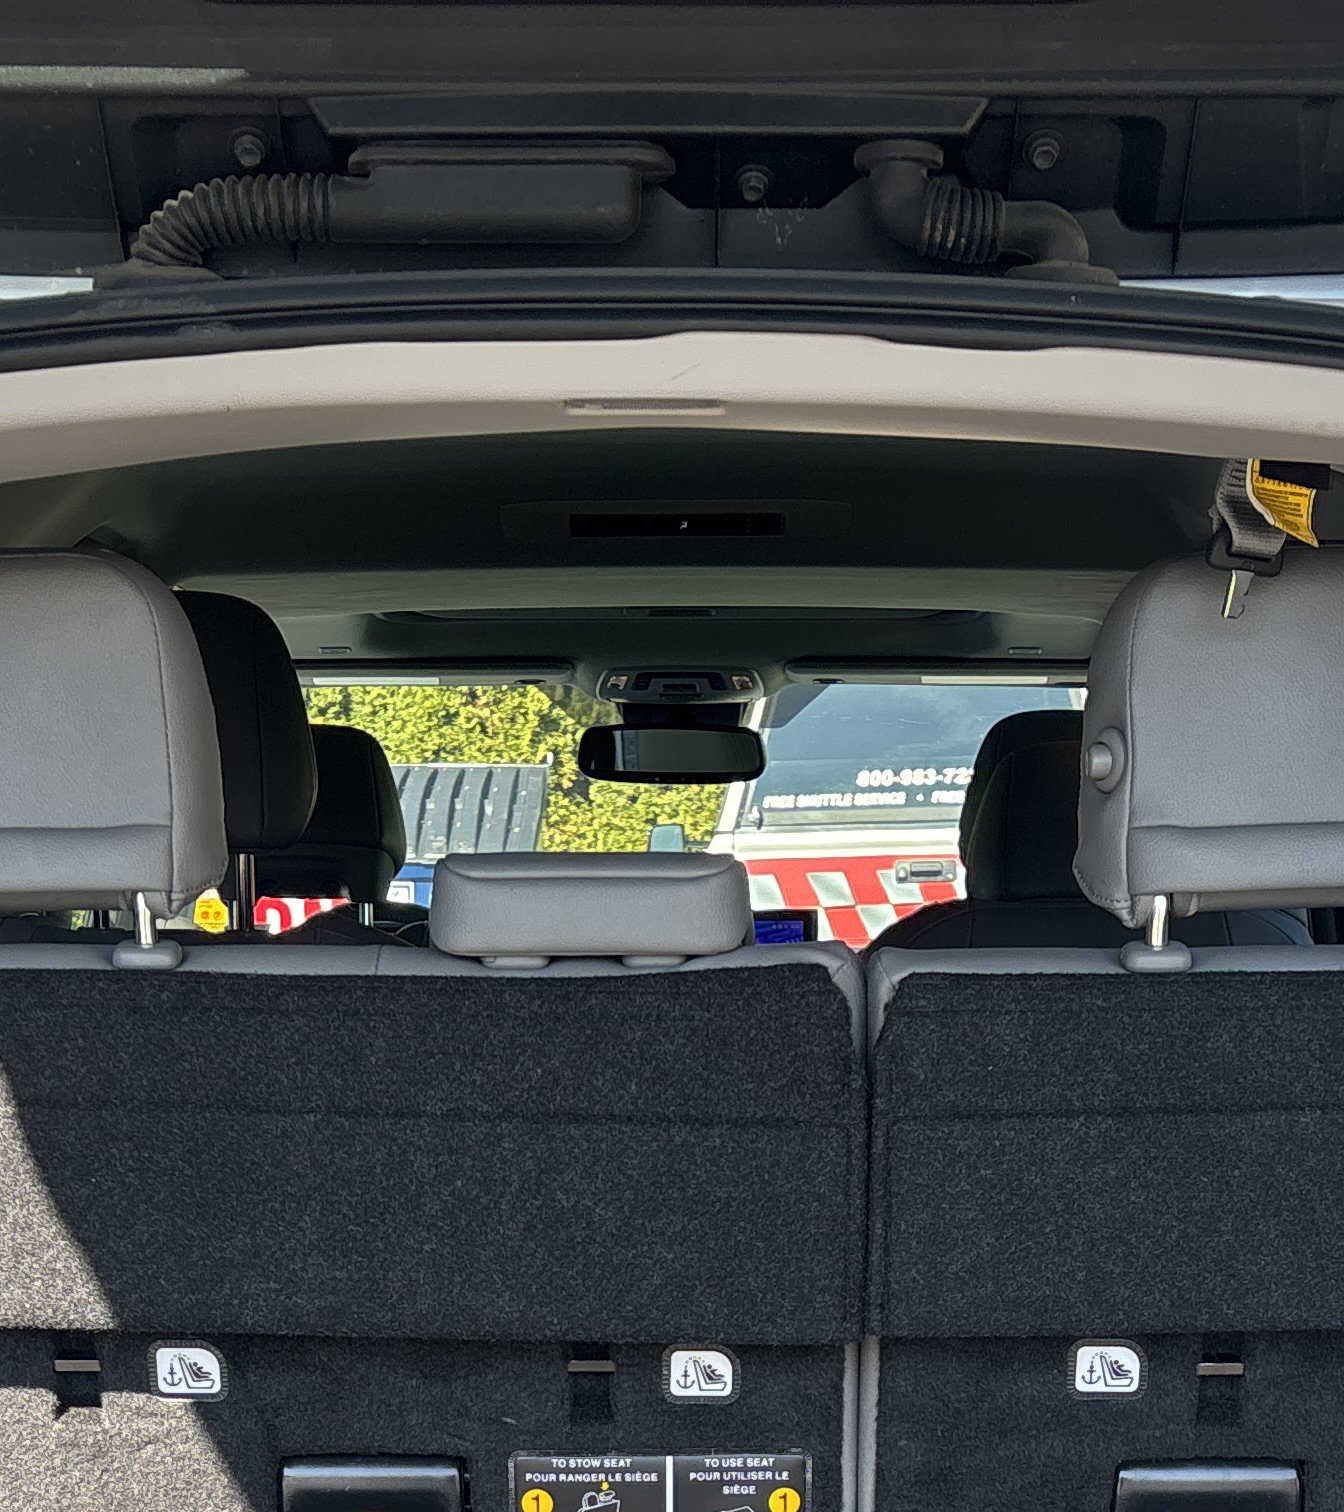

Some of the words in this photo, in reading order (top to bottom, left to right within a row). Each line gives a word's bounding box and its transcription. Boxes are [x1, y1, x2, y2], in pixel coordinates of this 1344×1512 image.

[796, 793, 854, 808] SHUTTLE
[854, 791, 906, 806] SERVICE
[551, 1458, 566, 1468] TO
[568, 1458, 601, 1468] STOW
[603, 1458, 632, 1468] SEAT
[704, 1458, 719, 1468] TO
[721, 1458, 744, 1468] USE
[746, 1457, 775, 1467] SEAT
[525, 1472, 557, 1482] POUR
[559, 1472, 606, 1482] RANGER
[607, 1472, 622, 1482] LE
[624, 1471, 658, 1482] SIÈGE
[689, 1472, 720, 1481] POUR
[723, 1471, 773, 1480] UTILISER
[775, 1471, 789, 1480] LE
[722, 1484, 757, 1495] SIÈGE
